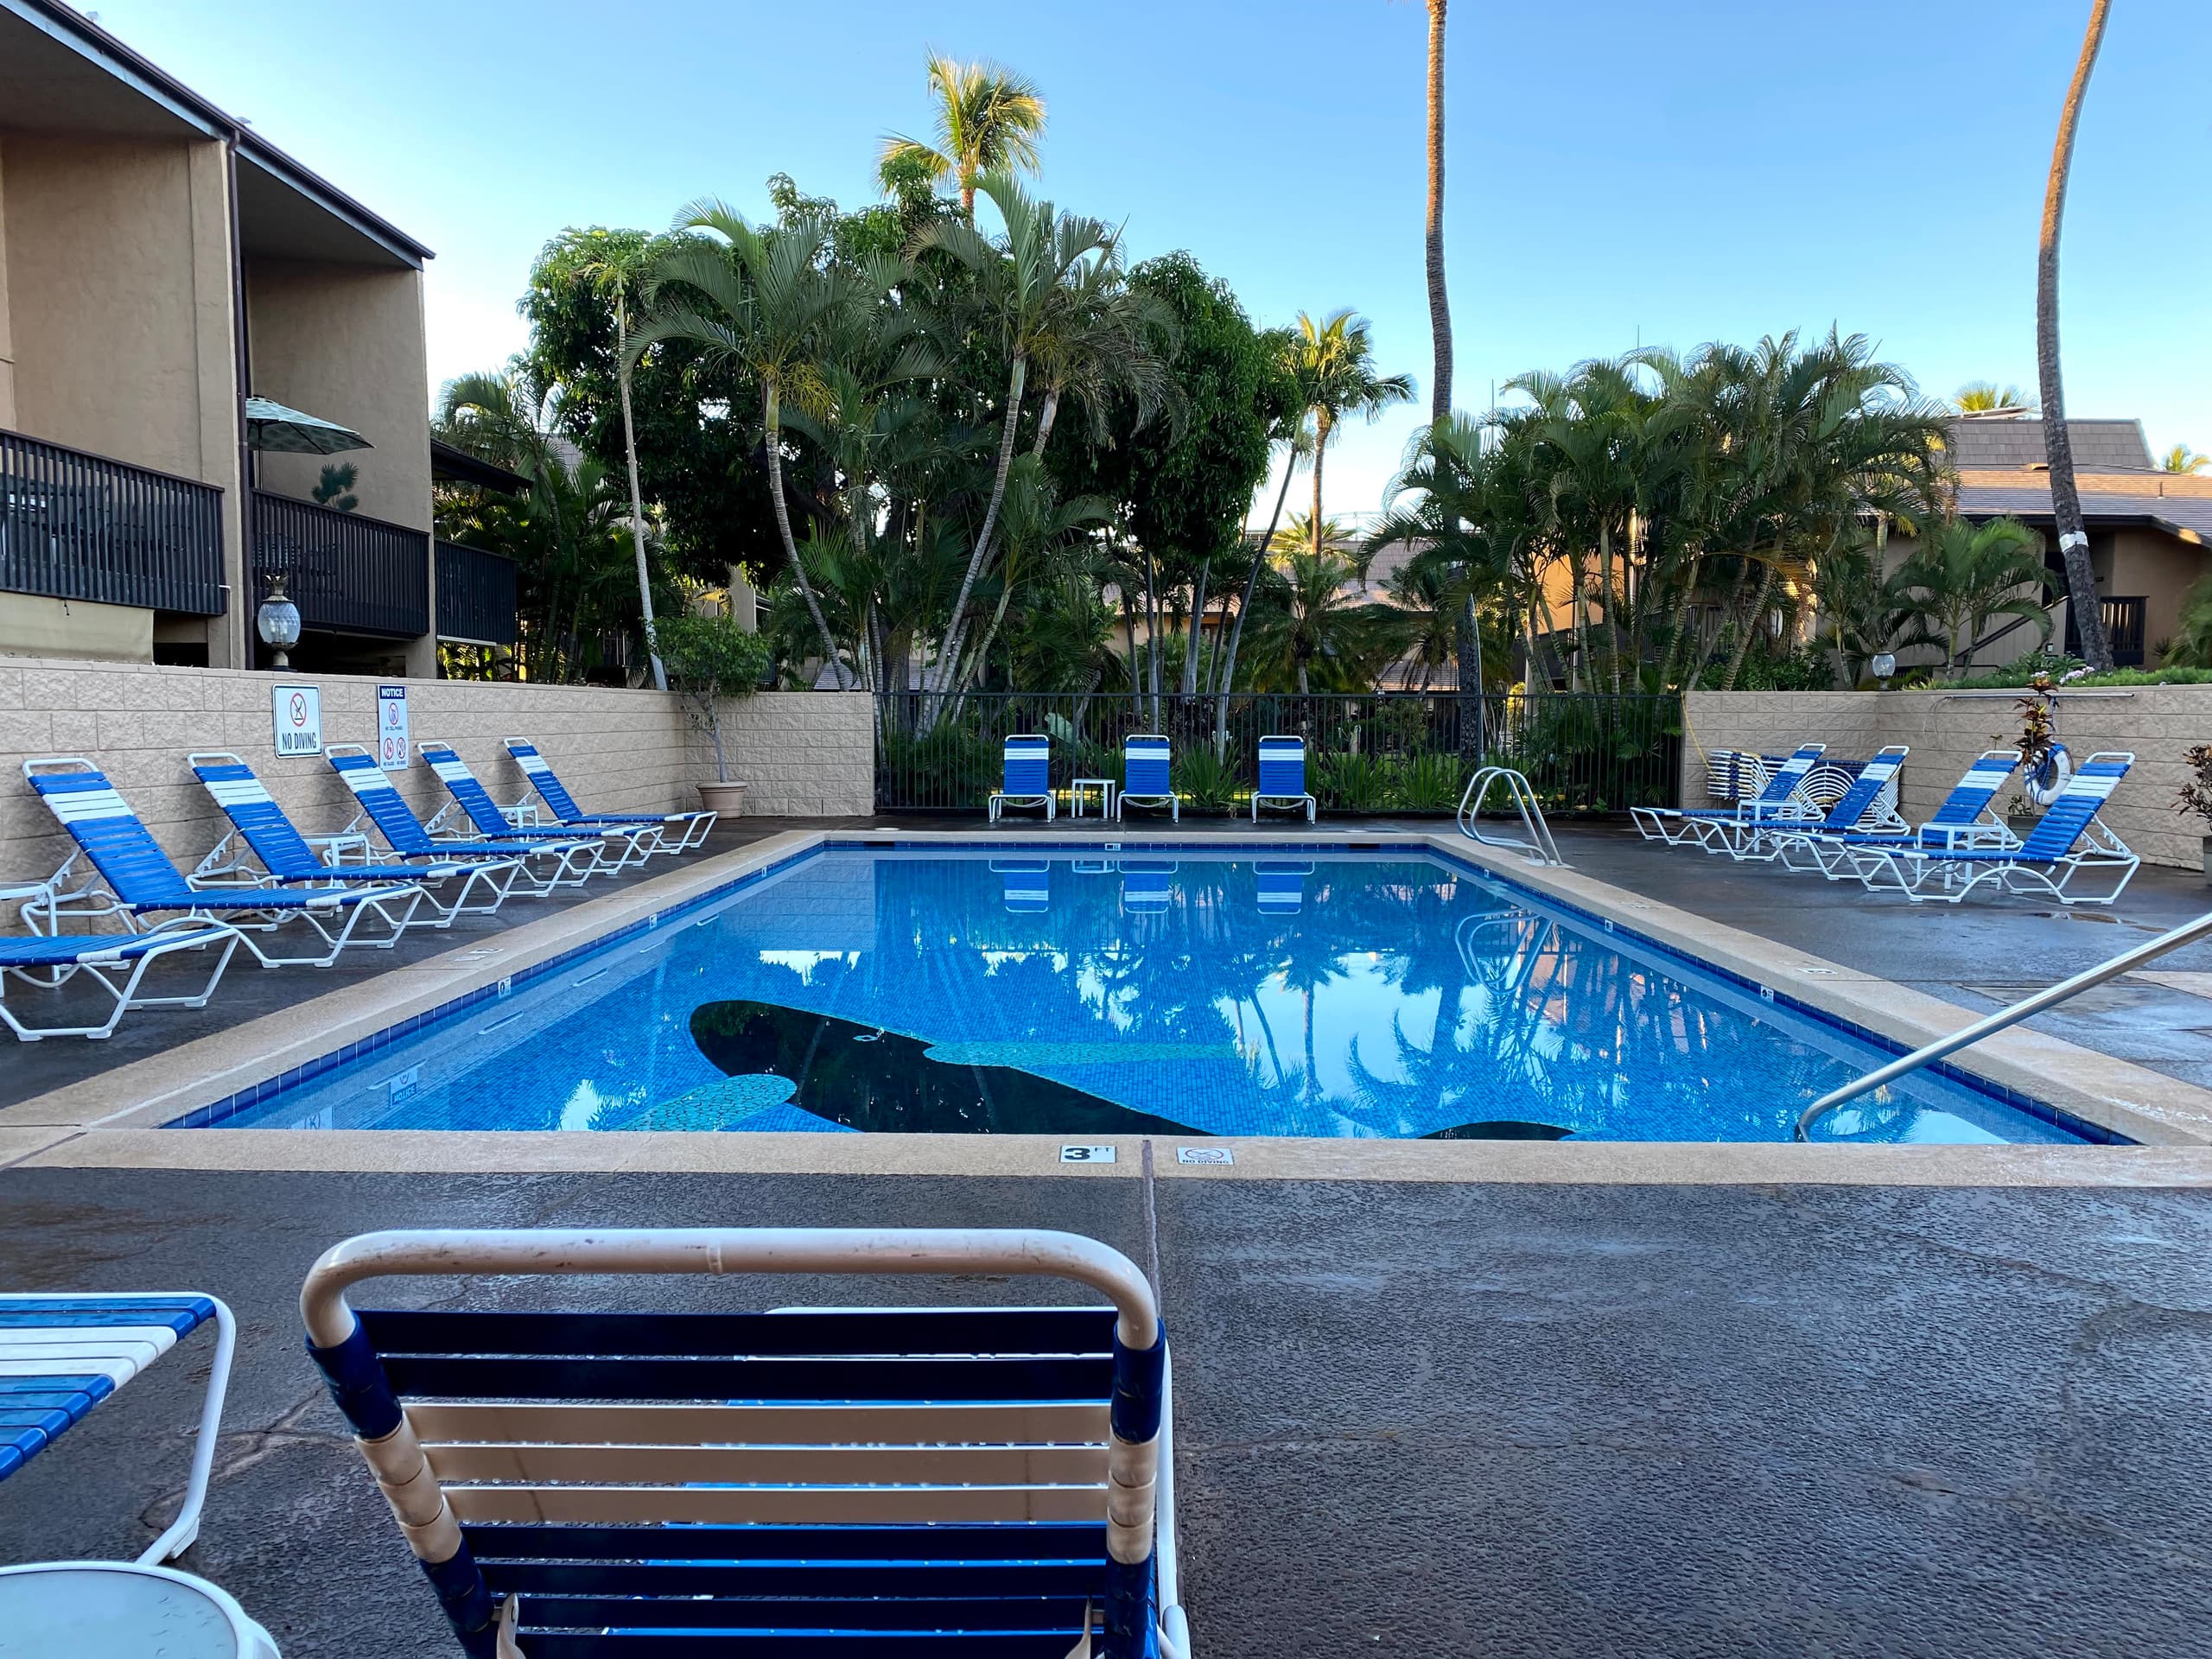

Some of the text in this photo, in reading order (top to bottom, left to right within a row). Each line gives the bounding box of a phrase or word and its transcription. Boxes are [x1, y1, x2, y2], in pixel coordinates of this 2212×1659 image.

[381, 687, 404, 697] NOTICE
[282, 732, 316, 750] NO DIVING
[1064, 1147, 1090, 1160] 3
